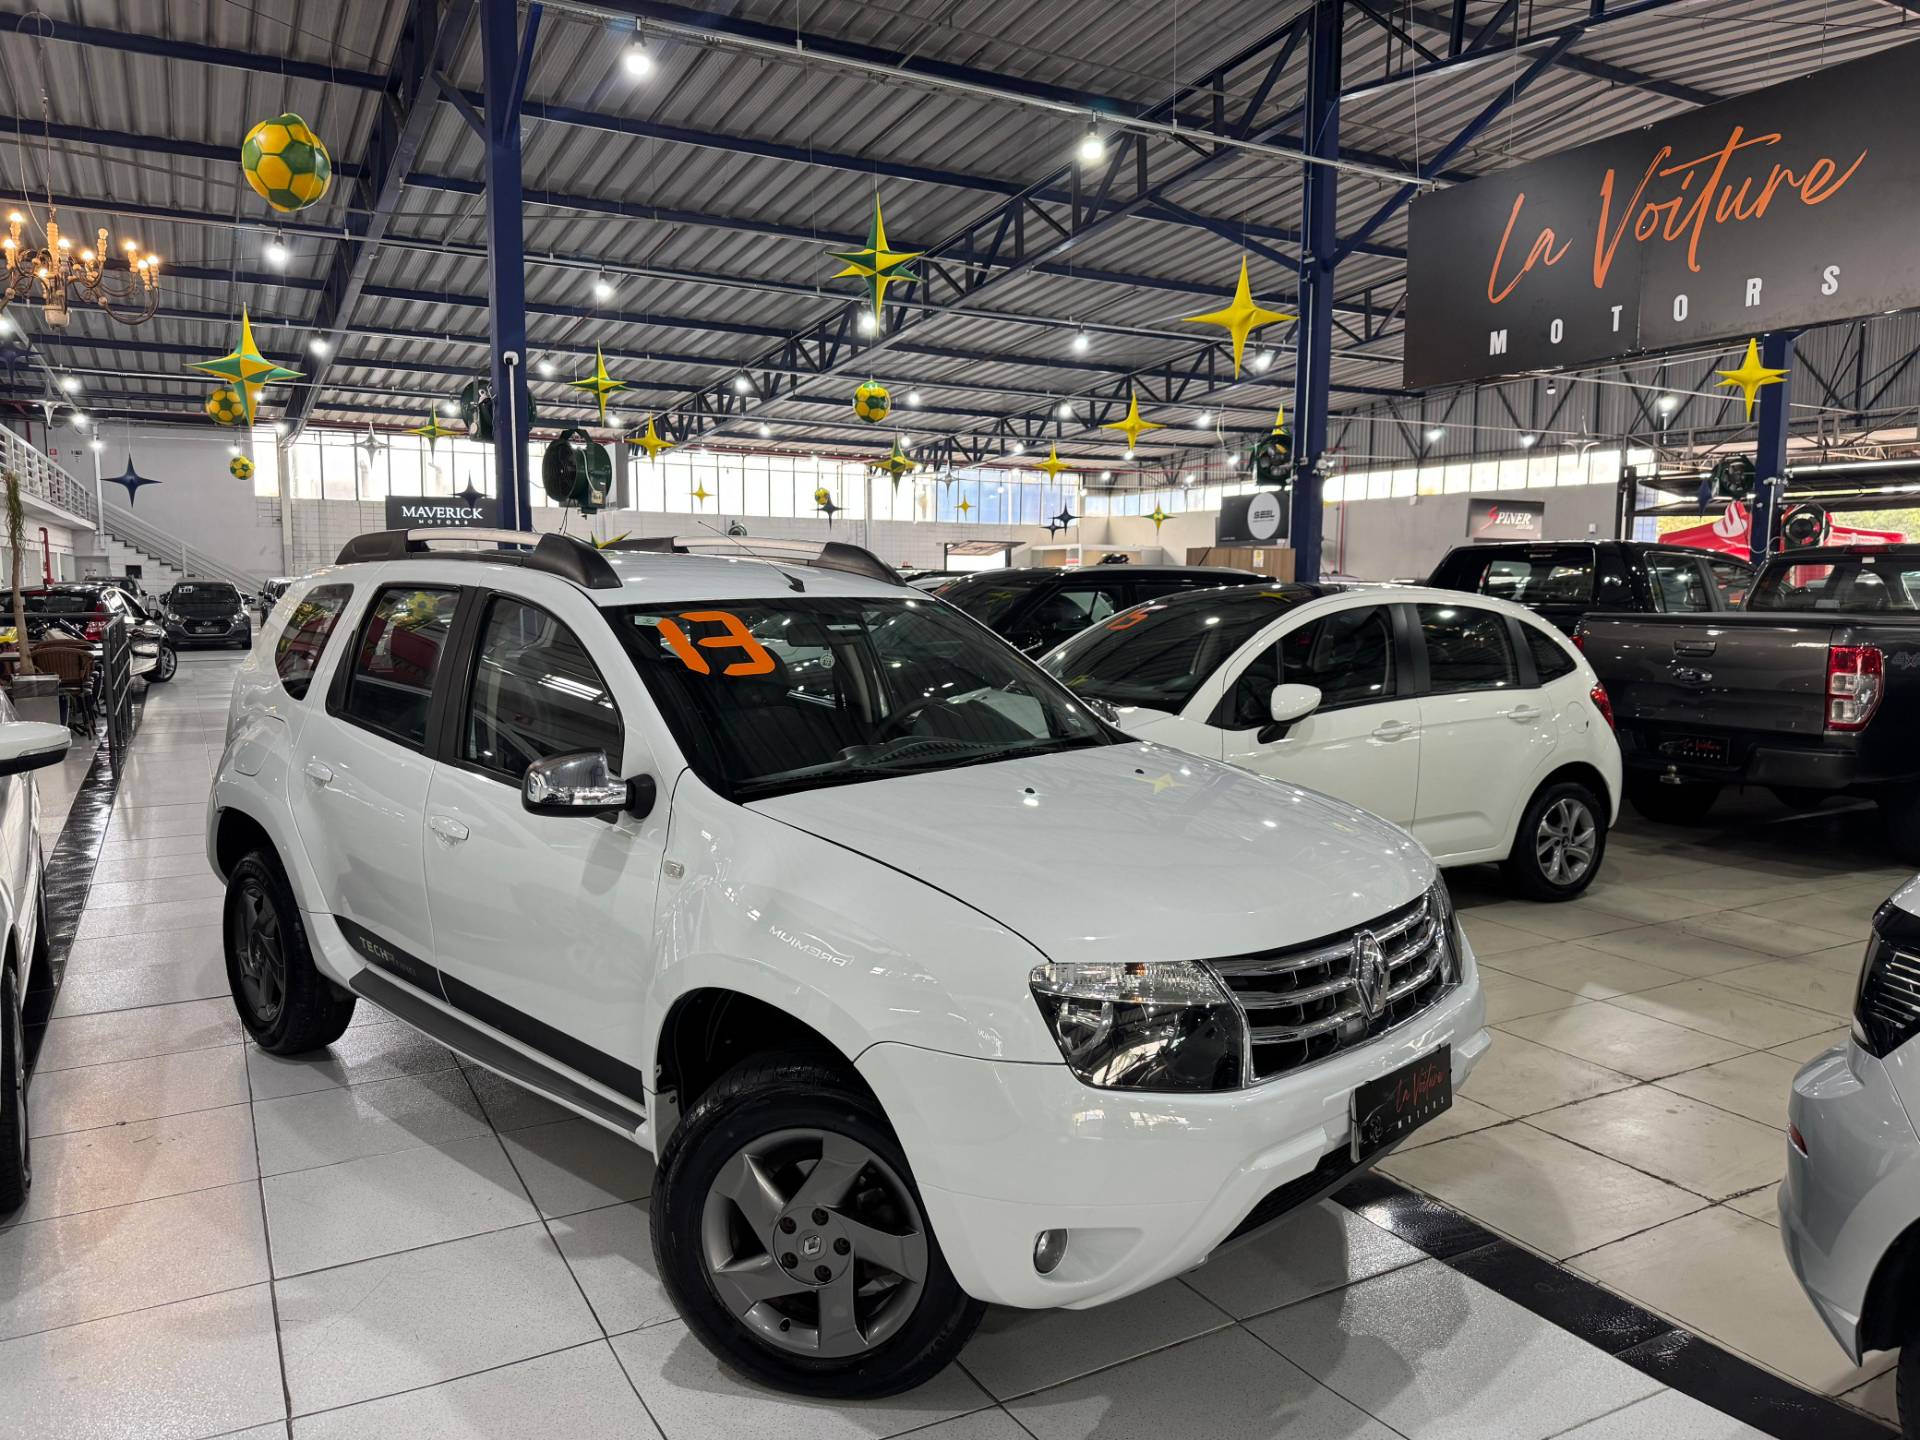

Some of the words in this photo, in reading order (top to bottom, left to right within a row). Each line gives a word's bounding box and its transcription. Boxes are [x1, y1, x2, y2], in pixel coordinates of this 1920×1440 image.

[1487, 192, 1574, 304] La
[1593, 126, 1868, 289] Voiture
[1489, 265, 1840, 356] MOTORS
[401, 505, 484, 520] MAVERICK
[1484, 503, 1532, 527] SPINER
[656, 611, 776, 676] 13
